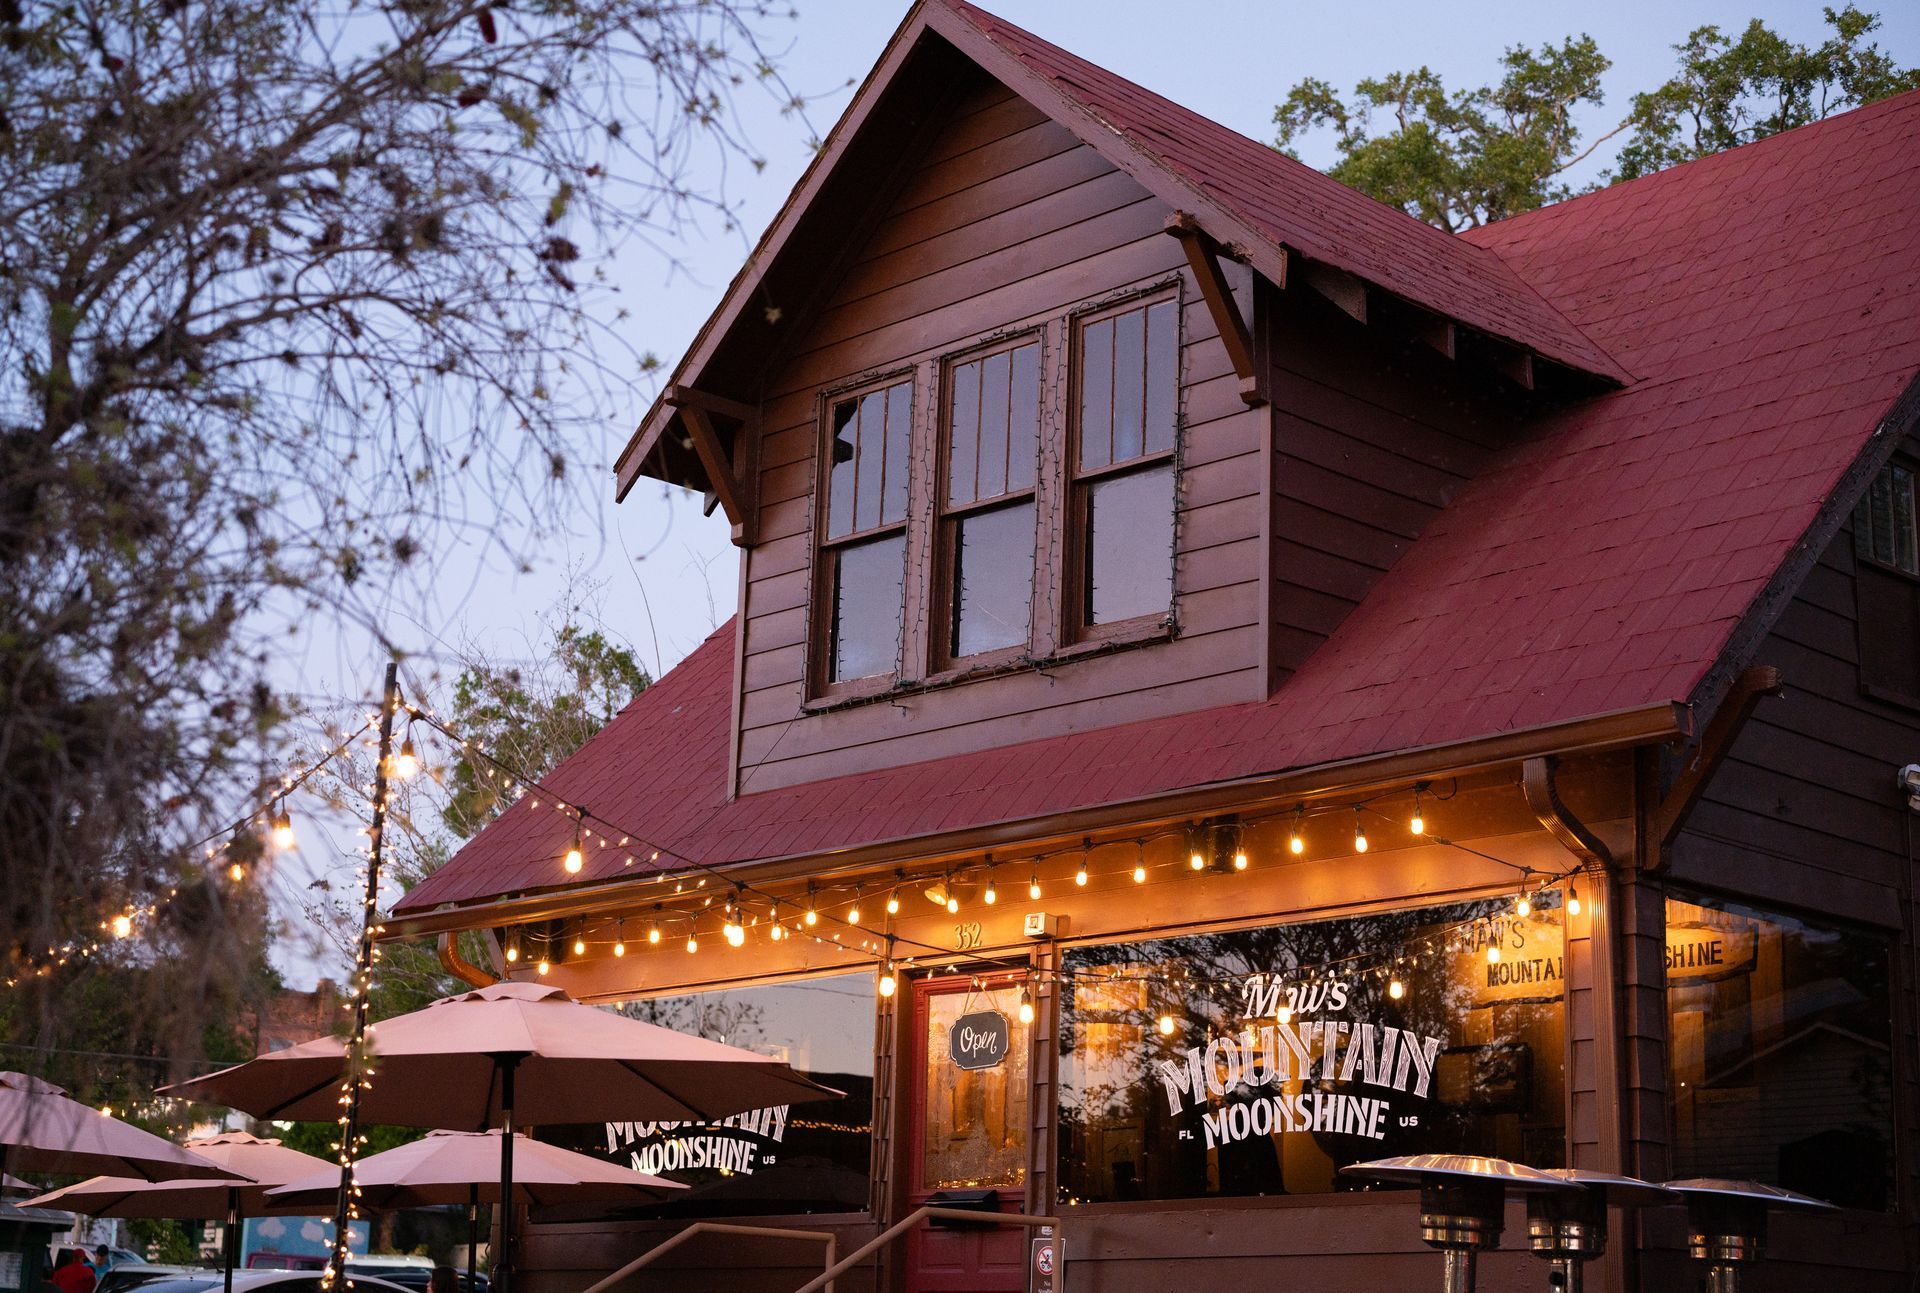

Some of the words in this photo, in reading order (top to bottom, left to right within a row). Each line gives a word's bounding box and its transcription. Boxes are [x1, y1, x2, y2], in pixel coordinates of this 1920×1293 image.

[954, 922, 982, 950] 352
[960, 1026, 998, 1058] Open
[1160, 1021, 1440, 1117] MOUNTAIN
[1178, 1130, 1194, 1140] FL
[1202, 1093, 1390, 1150] MOONSHINE
[1399, 1116, 1419, 1127] US
[630, 1136, 758, 1176] MOONSHINE
[762, 1155, 776, 1165] US
